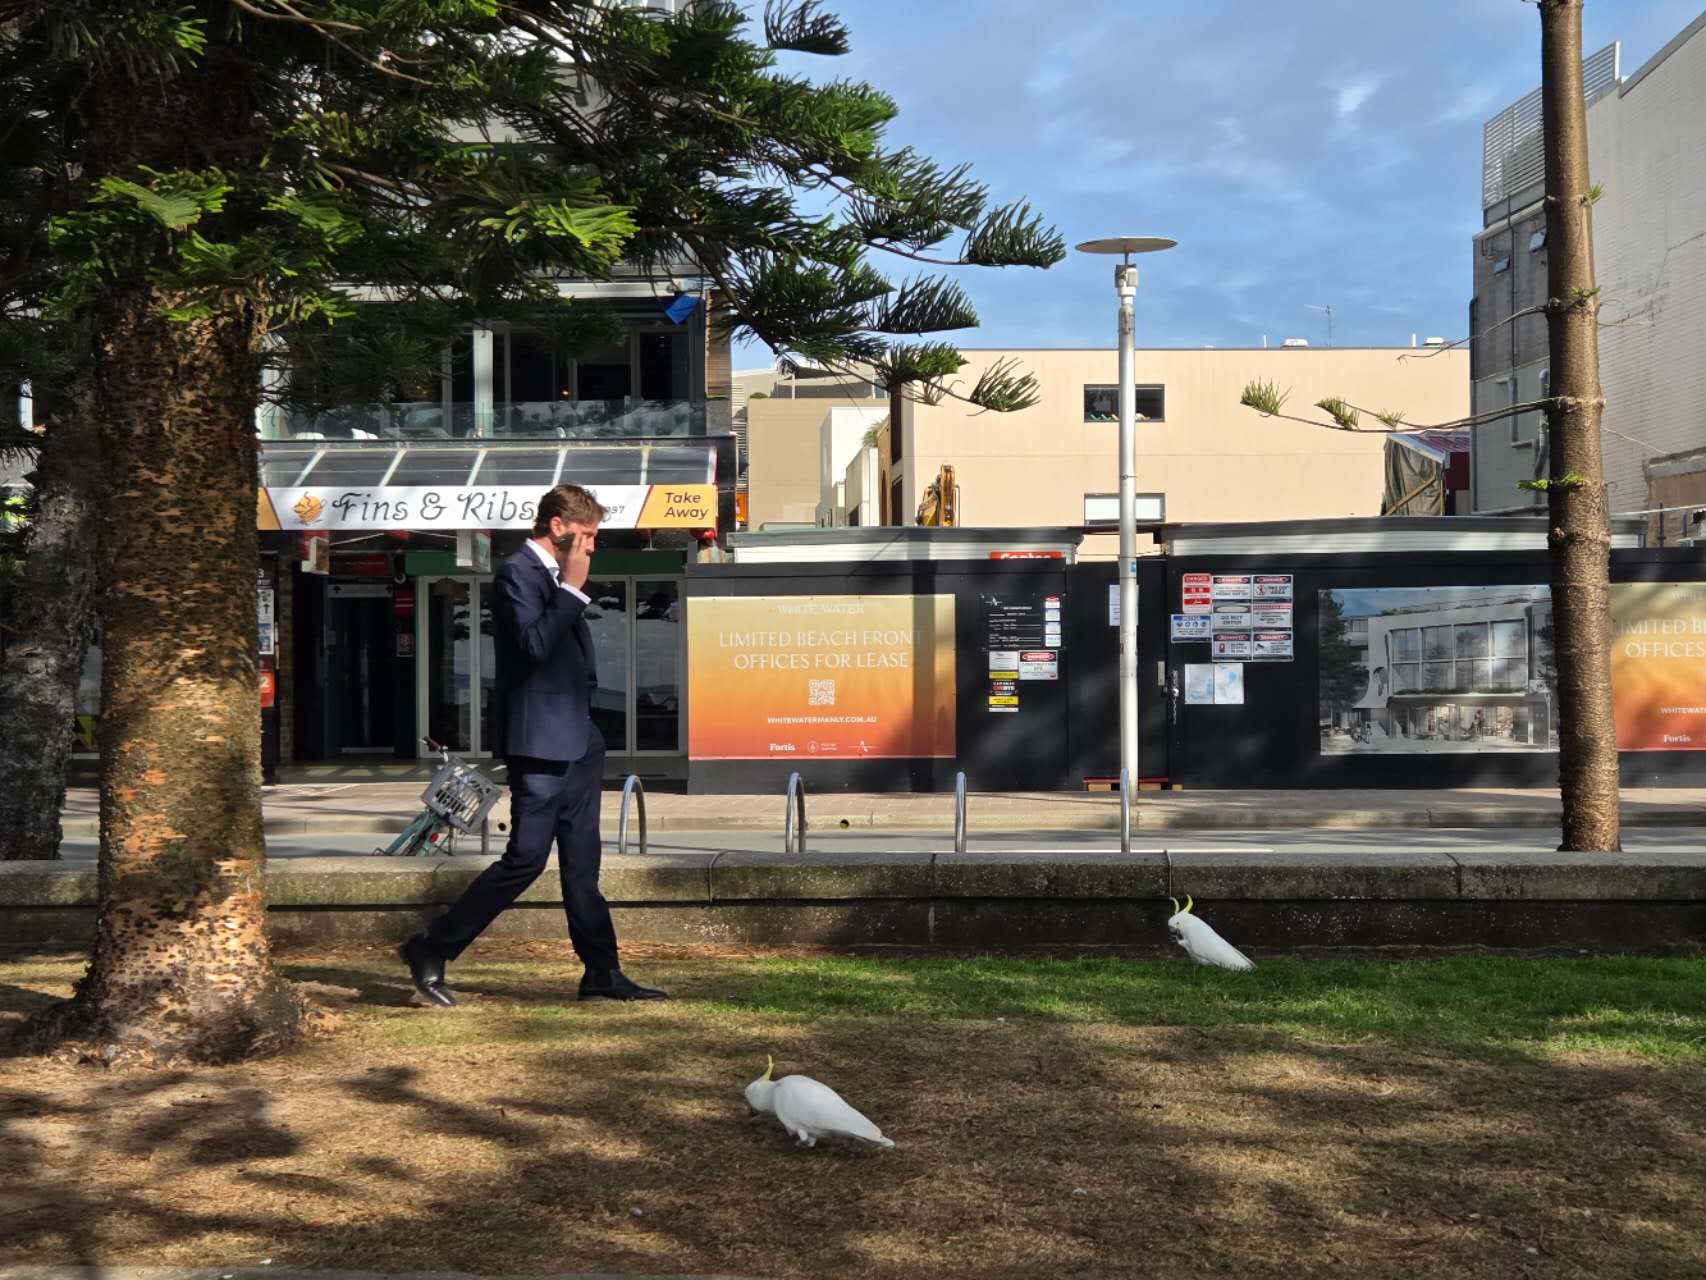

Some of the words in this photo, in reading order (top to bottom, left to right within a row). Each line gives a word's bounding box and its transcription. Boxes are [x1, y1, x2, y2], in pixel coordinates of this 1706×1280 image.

[664, 492, 701, 503] Take
[332, 492, 409, 521] Fins
[420, 492, 448, 520] &
[457, 491, 535, 521] Ribs
[664, 507, 709, 520] Away
[719, 631, 791, 648] LIMITED
[797, 630, 857, 647] BEACH
[734, 653, 810, 670] OFFICES
[816, 653, 851, 669] FOR
[856, 652, 909, 669] LEASE
[767, 715, 878, 725] WHITEWATERMANLY.COM.AU
[769, 743, 796, 752] Fortis
